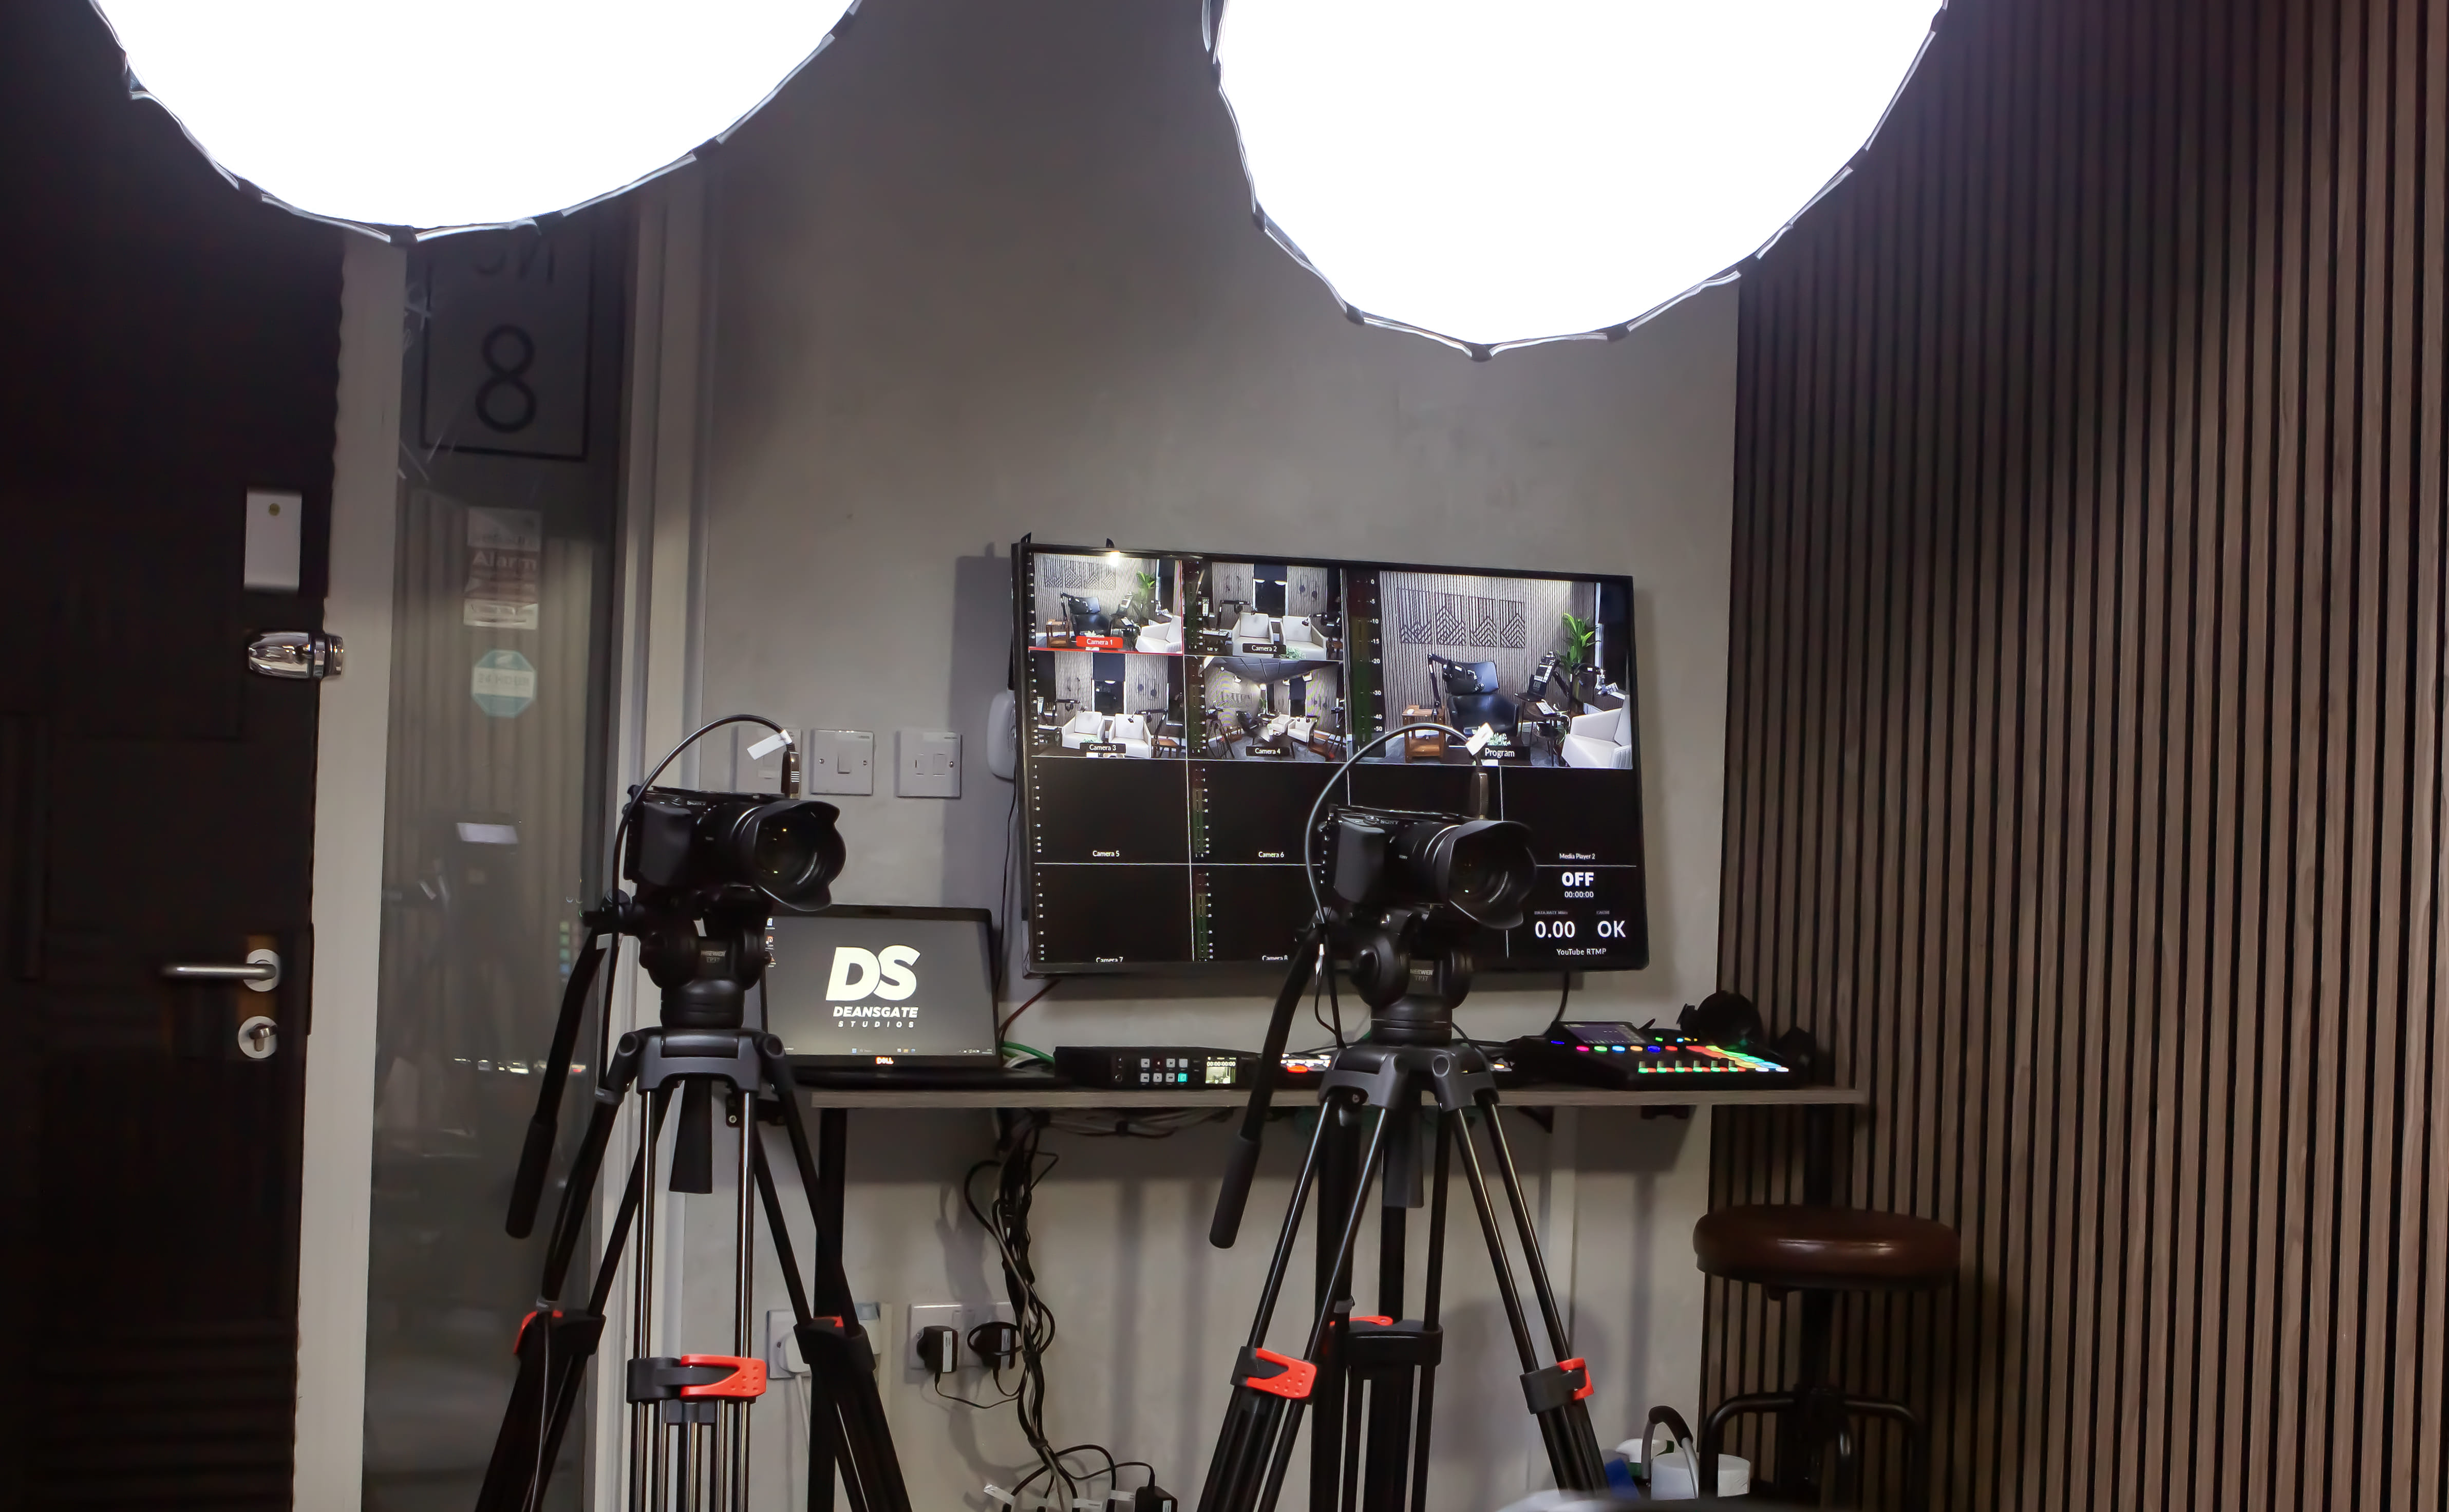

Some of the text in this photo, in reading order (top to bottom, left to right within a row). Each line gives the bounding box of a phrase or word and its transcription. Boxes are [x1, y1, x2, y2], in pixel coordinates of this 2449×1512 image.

[473, 550, 537, 570] Alarm
[1485, 748, 1515, 758] Program
[1562, 872, 1594, 886] OFF
[1535, 921, 1575, 938] 0.00
[1597, 920, 1626, 937] OK
[825, 945, 920, 1001] DS
[833, 1006, 919, 1018] DEANSGATE
